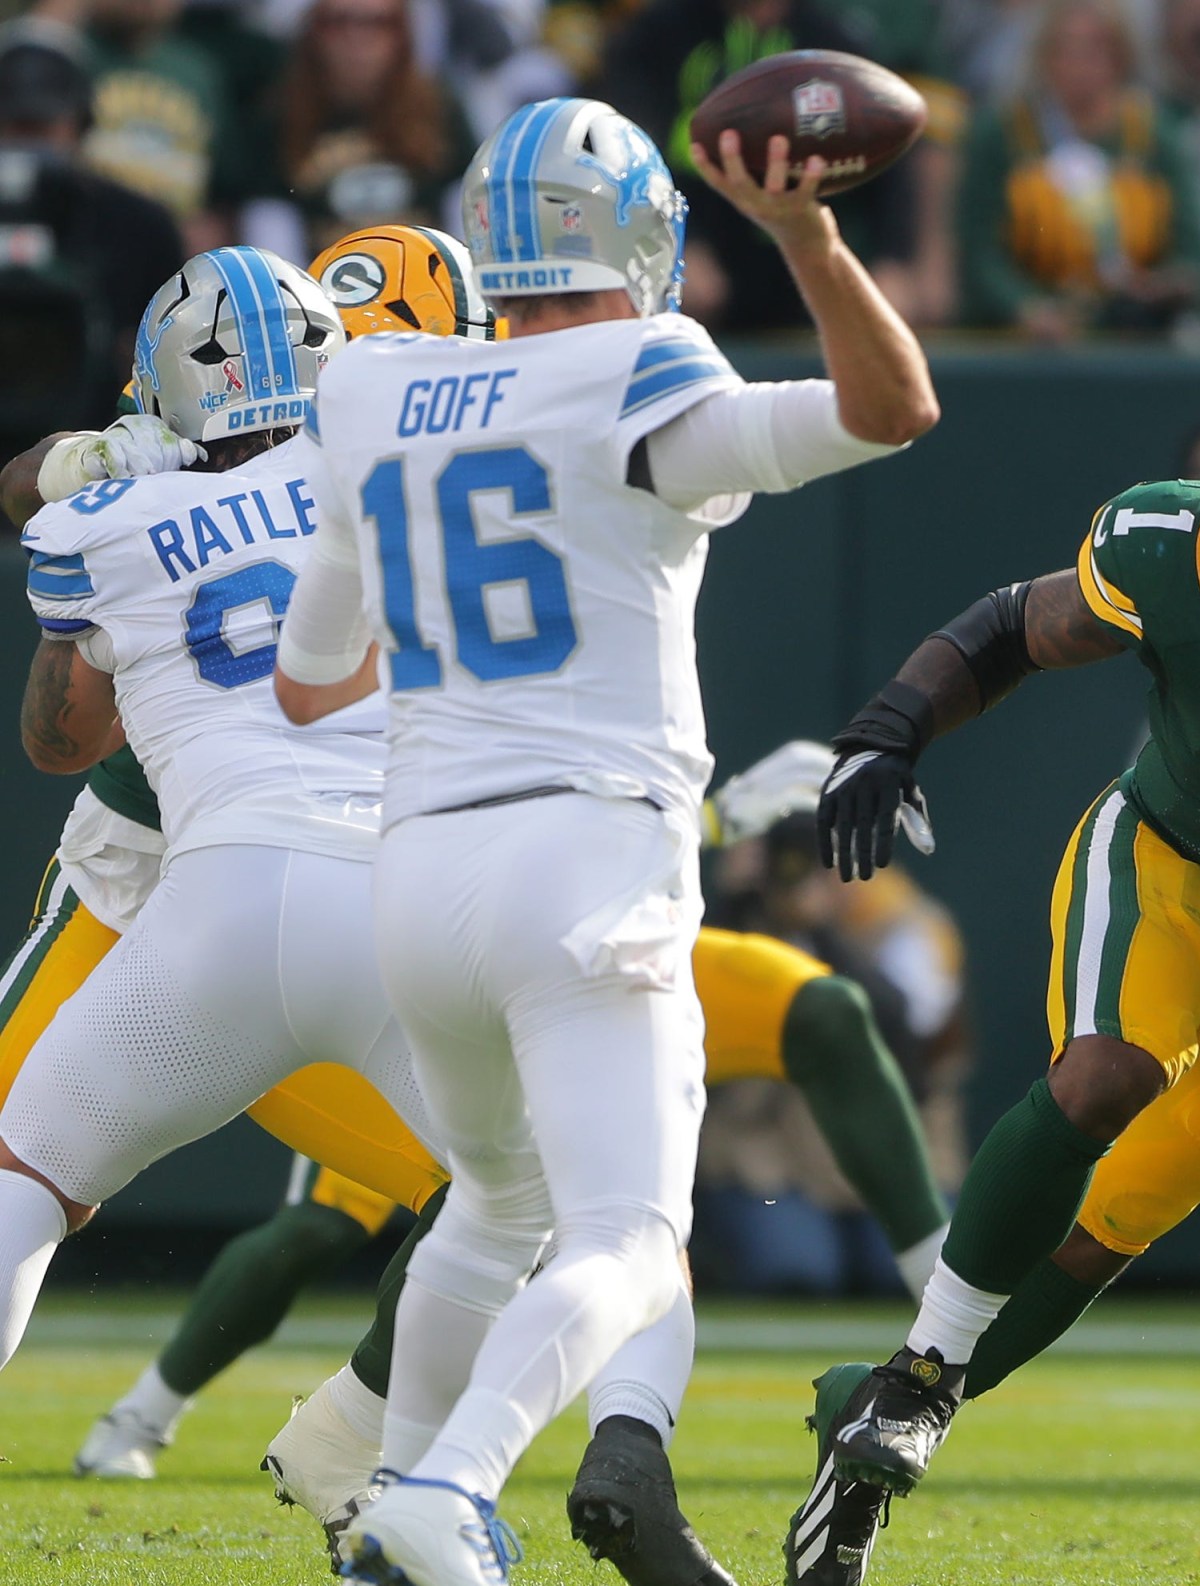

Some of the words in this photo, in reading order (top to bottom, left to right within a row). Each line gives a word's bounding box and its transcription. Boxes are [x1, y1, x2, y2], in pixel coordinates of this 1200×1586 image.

[481, 268, 572, 290] DETROIT
[261, 375, 283, 388] 69
[228, 399, 311, 430] DETROI
[397, 368, 518, 438] GOFF
[147, 478, 316, 583] RATLE
[1112, 508, 1195, 536] 1
[359, 441, 585, 692] 16
